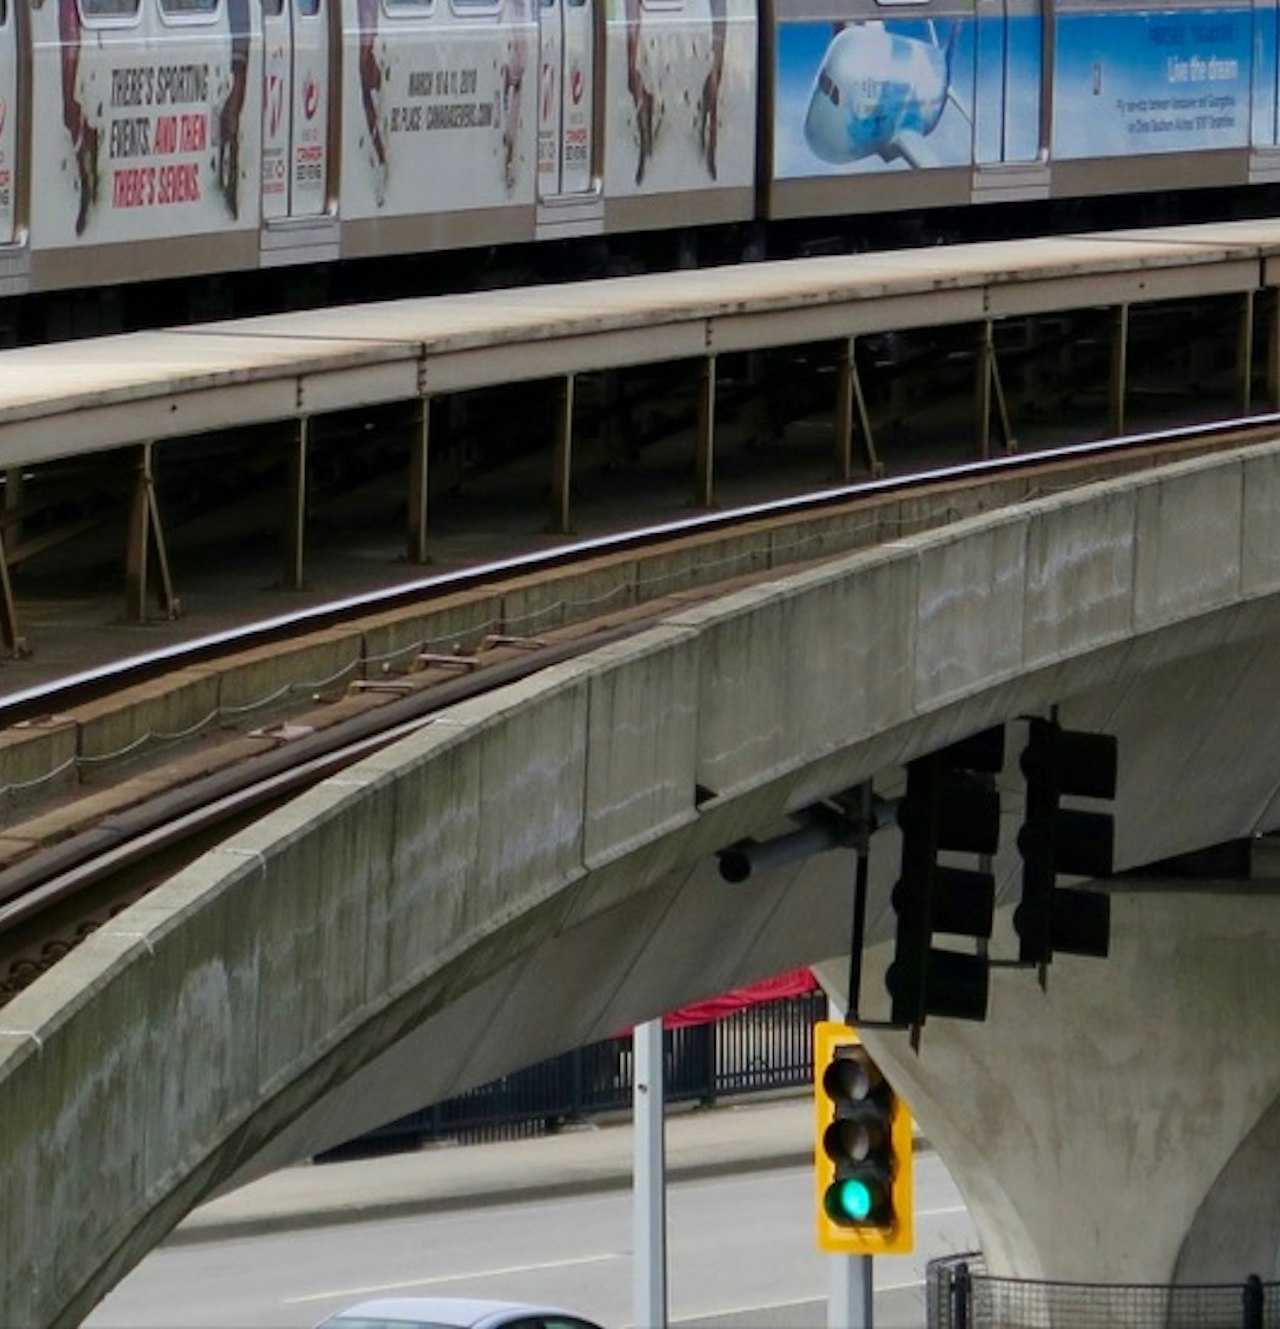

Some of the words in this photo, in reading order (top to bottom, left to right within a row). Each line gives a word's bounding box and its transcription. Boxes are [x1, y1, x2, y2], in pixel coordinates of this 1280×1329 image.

[110, 67, 154, 107] THERE'S
[156, 64, 208, 105] SPORTING
[408, 71, 433, 97] MARCH
[109, 117, 151, 158] EVENTS.
[153, 115, 177, 155] AND
[179, 113, 206, 154] THEN
[112, 168, 156, 208] THERE'S
[157, 163, 201, 204] SEVENS.
